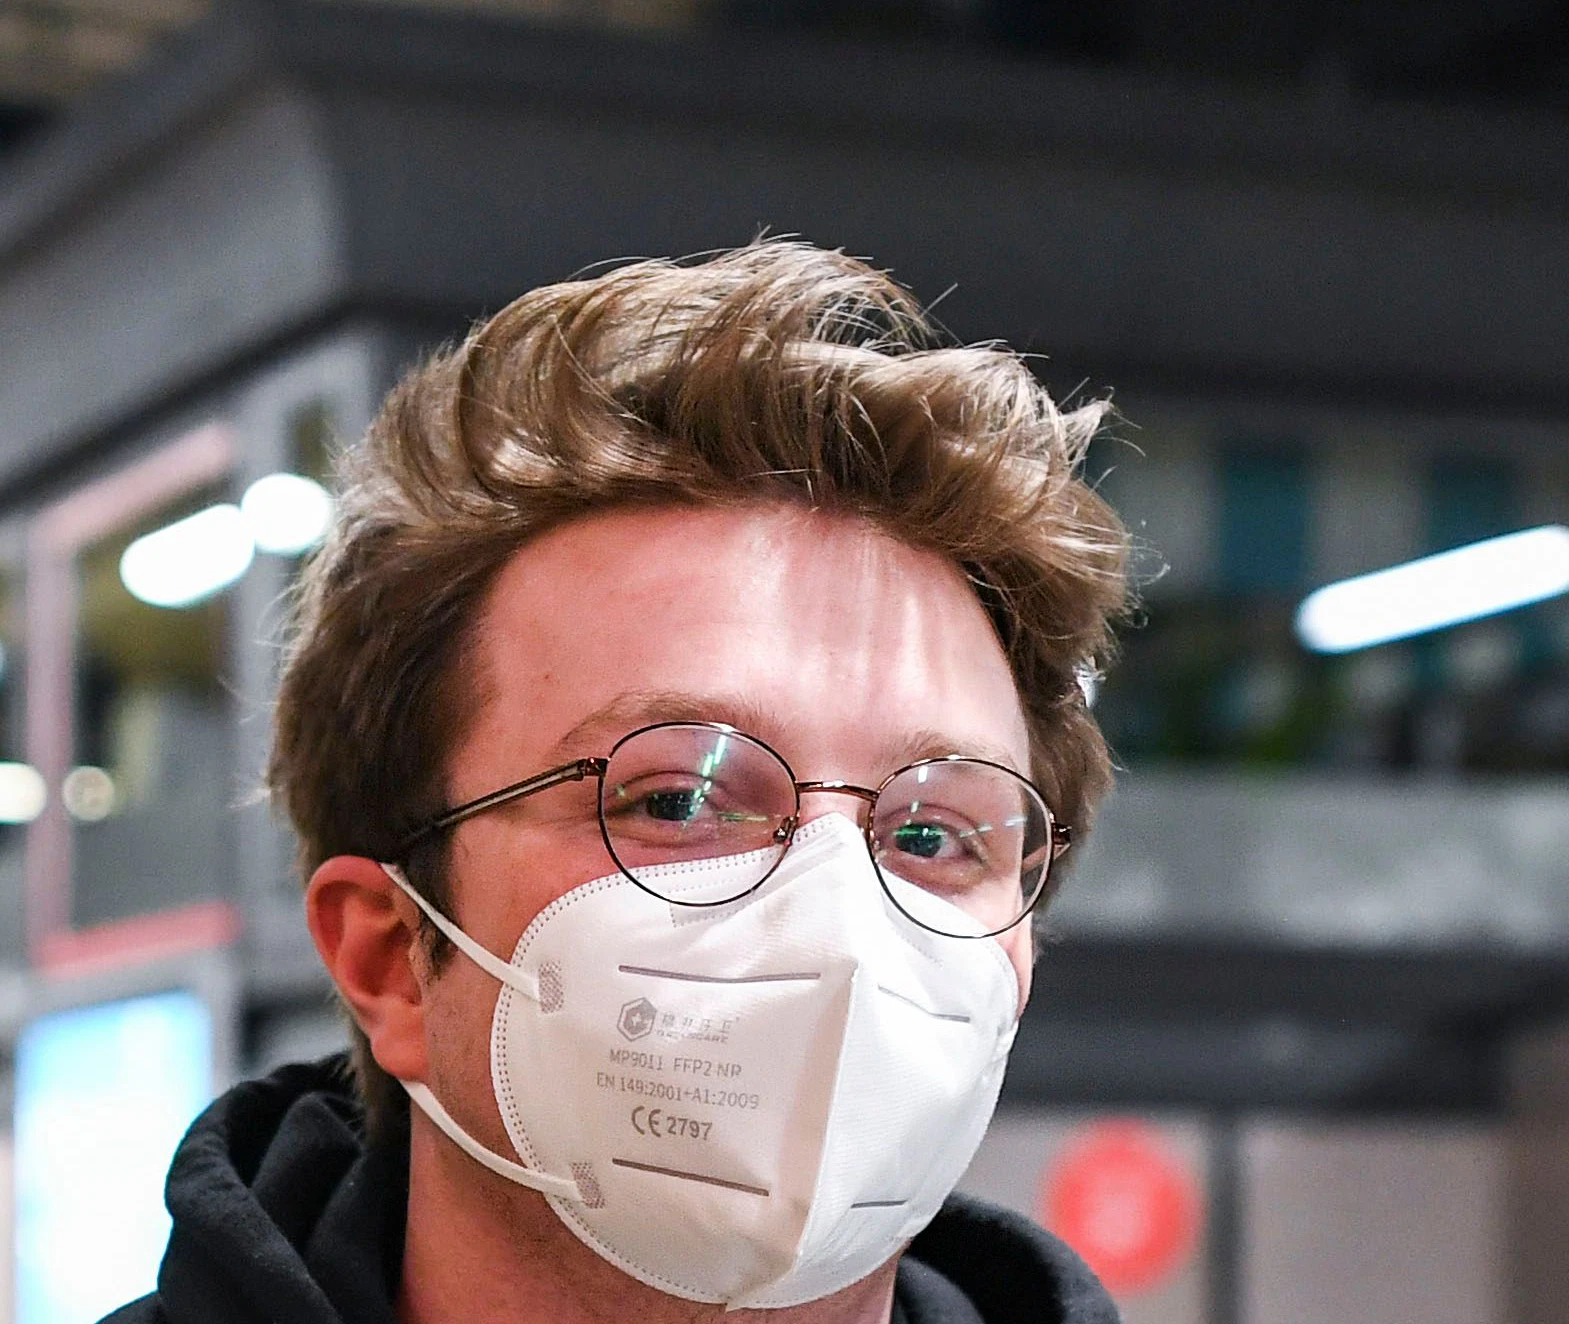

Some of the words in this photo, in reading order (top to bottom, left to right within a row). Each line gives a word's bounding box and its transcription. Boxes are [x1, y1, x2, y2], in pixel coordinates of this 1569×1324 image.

[609, 1049, 663, 1071] MP9011
[673, 1057, 712, 1077] FFP2
[716, 1062, 742, 1078] NR
[596, 1071, 615, 1089] EN
[620, 1077, 760, 1110] 149:2001+A1:2009
[631, 1105, 662, 1138] CE
[666, 1115, 713, 1141] 2797
